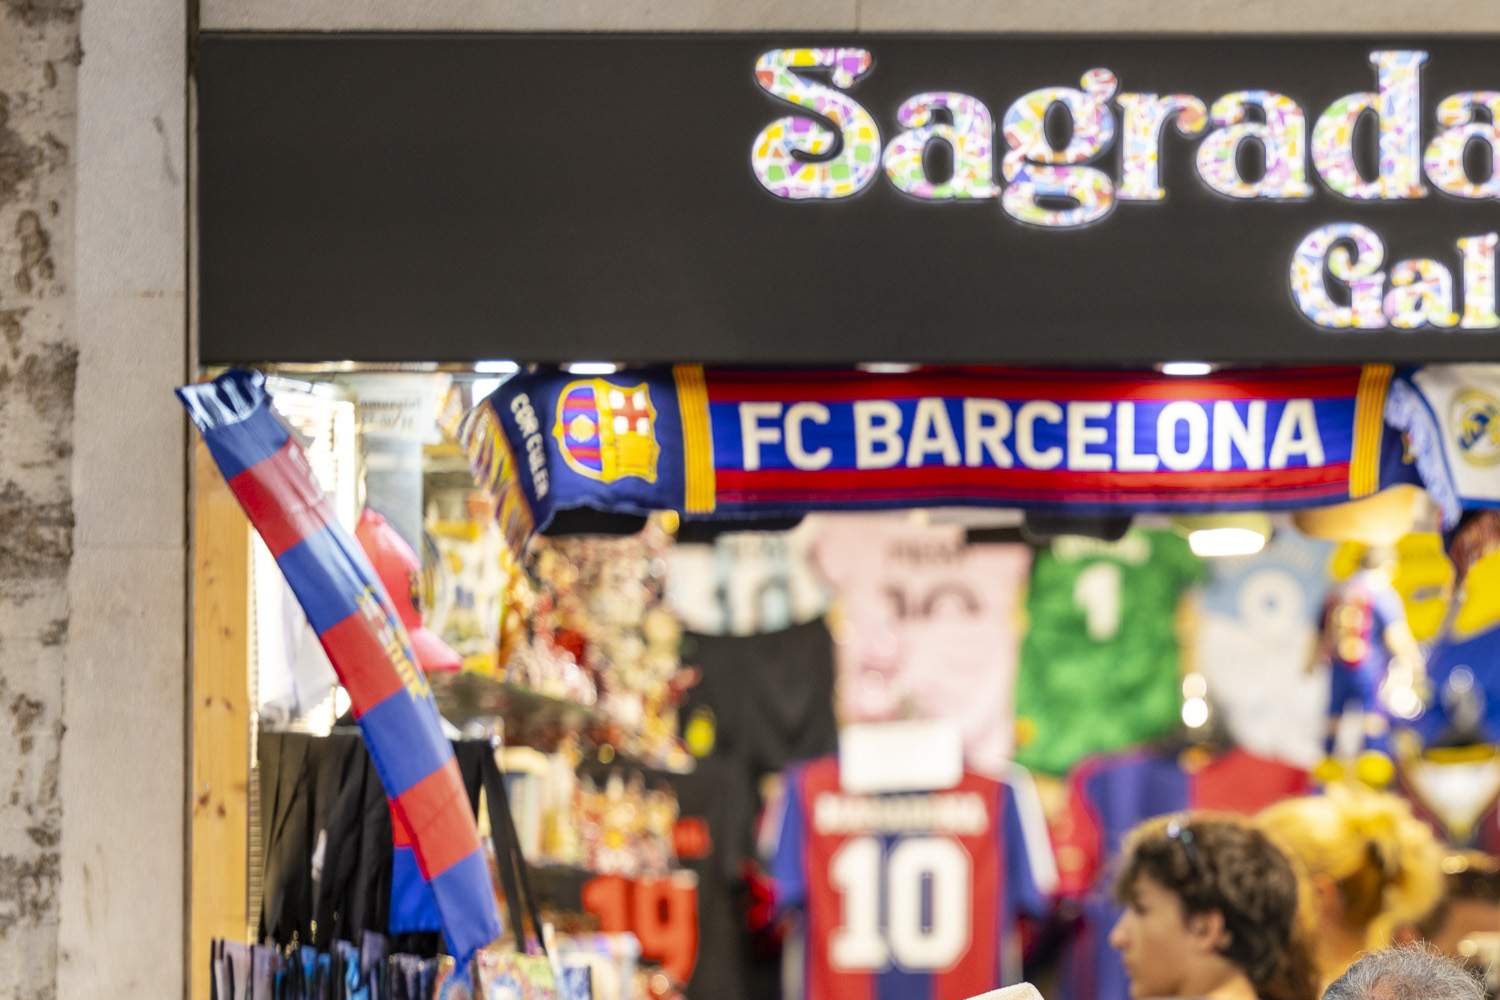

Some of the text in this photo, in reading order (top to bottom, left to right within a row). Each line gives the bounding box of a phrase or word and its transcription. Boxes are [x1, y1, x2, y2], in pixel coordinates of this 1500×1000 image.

[511, 393, 539, 439] COR
[738, 397, 1325, 472] FC BARCELONA
[1073, 563, 1123, 642] 1
[582, 872, 698, 985] 19
[827, 835, 973, 974] 10
